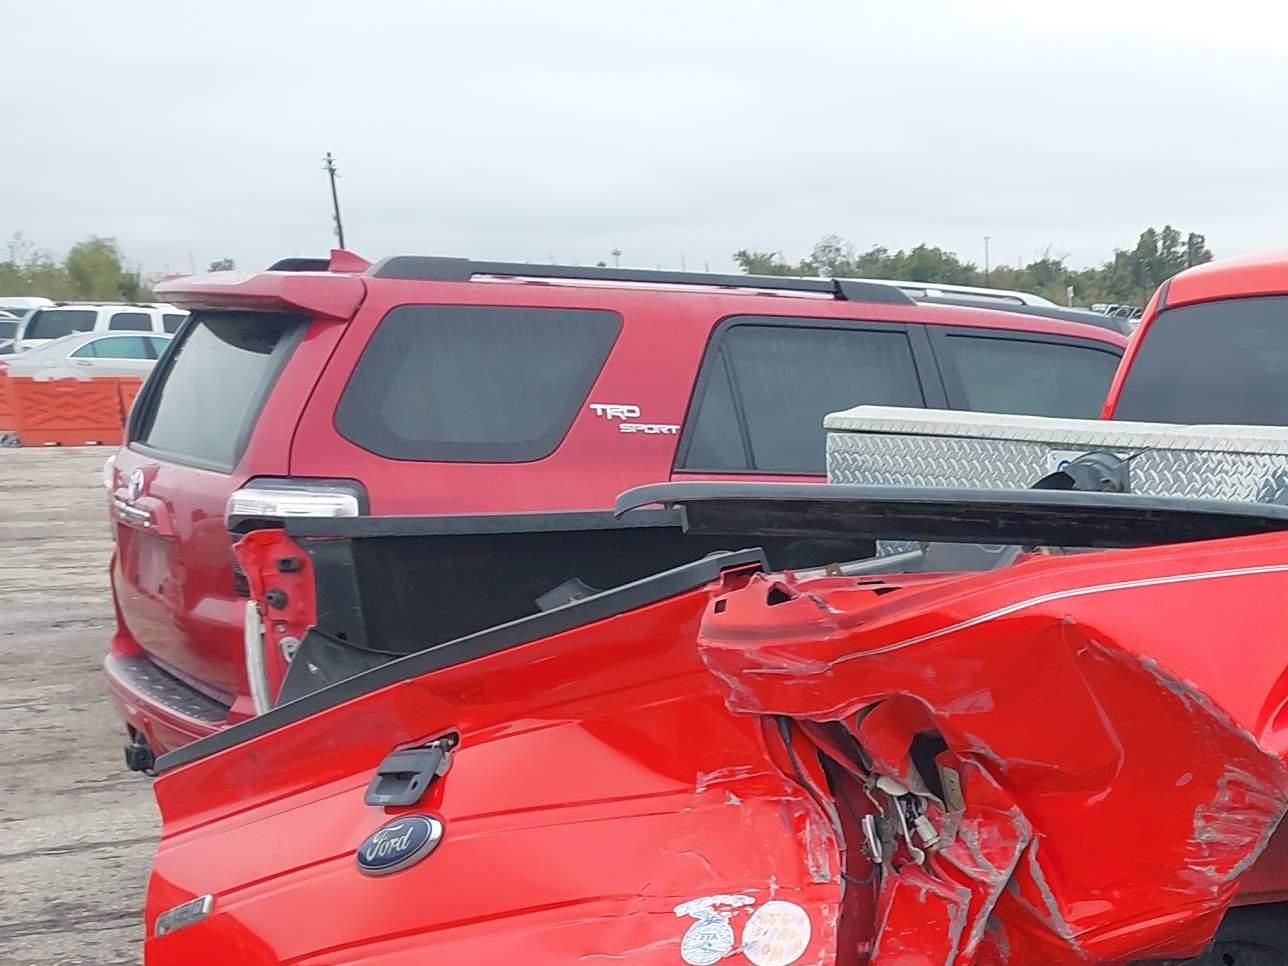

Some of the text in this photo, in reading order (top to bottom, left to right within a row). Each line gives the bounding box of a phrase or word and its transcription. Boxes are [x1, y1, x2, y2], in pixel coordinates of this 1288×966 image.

[590, 404, 640, 420] TRD
[619, 424, 680, 434] SPORT
[366, 823, 415, 861] Ford
